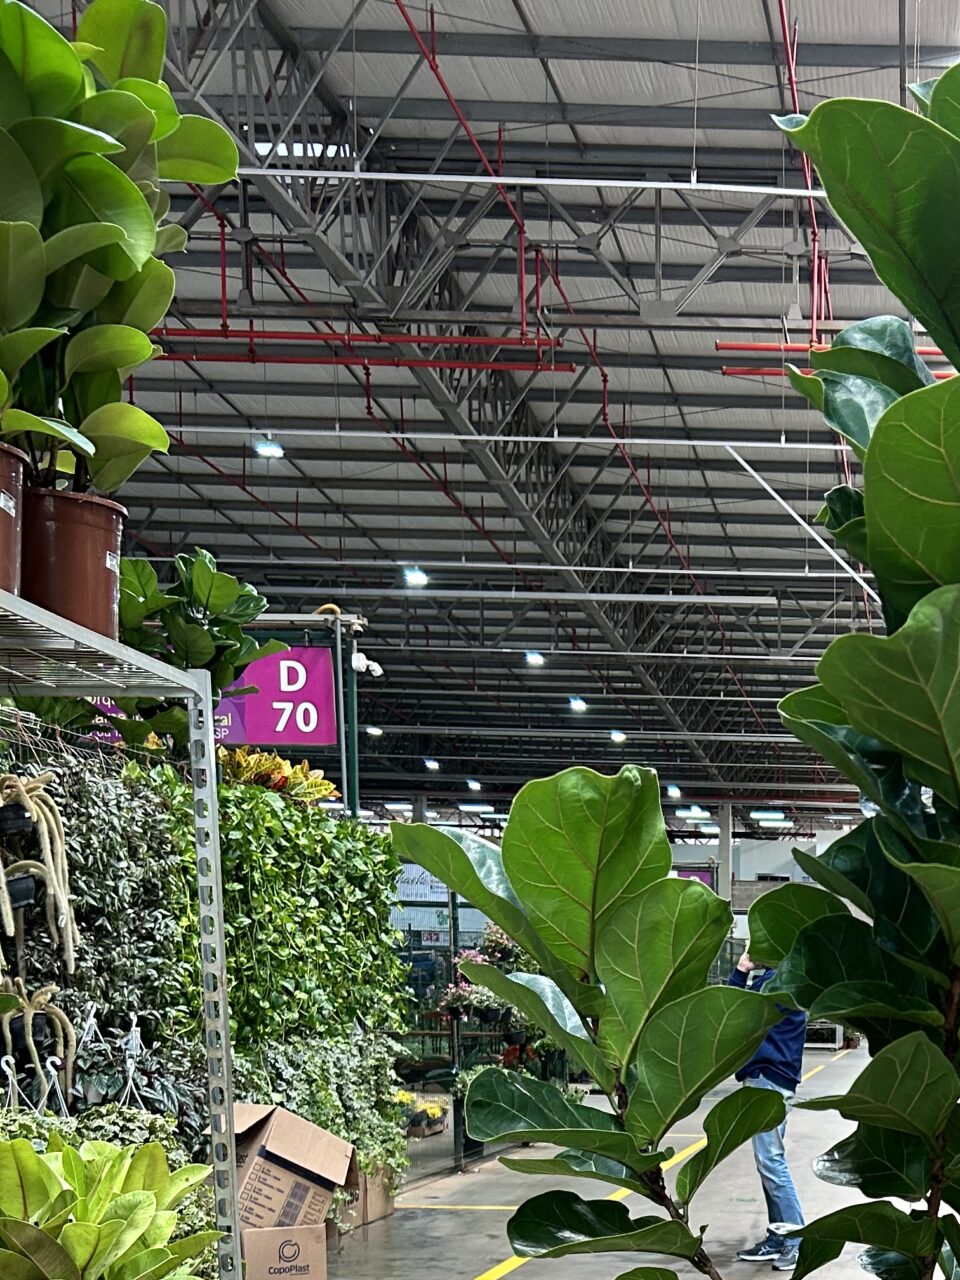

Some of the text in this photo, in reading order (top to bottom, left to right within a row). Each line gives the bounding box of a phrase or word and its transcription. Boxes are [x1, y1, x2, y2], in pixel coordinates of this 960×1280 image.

[279, 660, 307, 691] D
[272, 701, 318, 733] 70
[268, 1264, 310, 1275] CopoPlast
